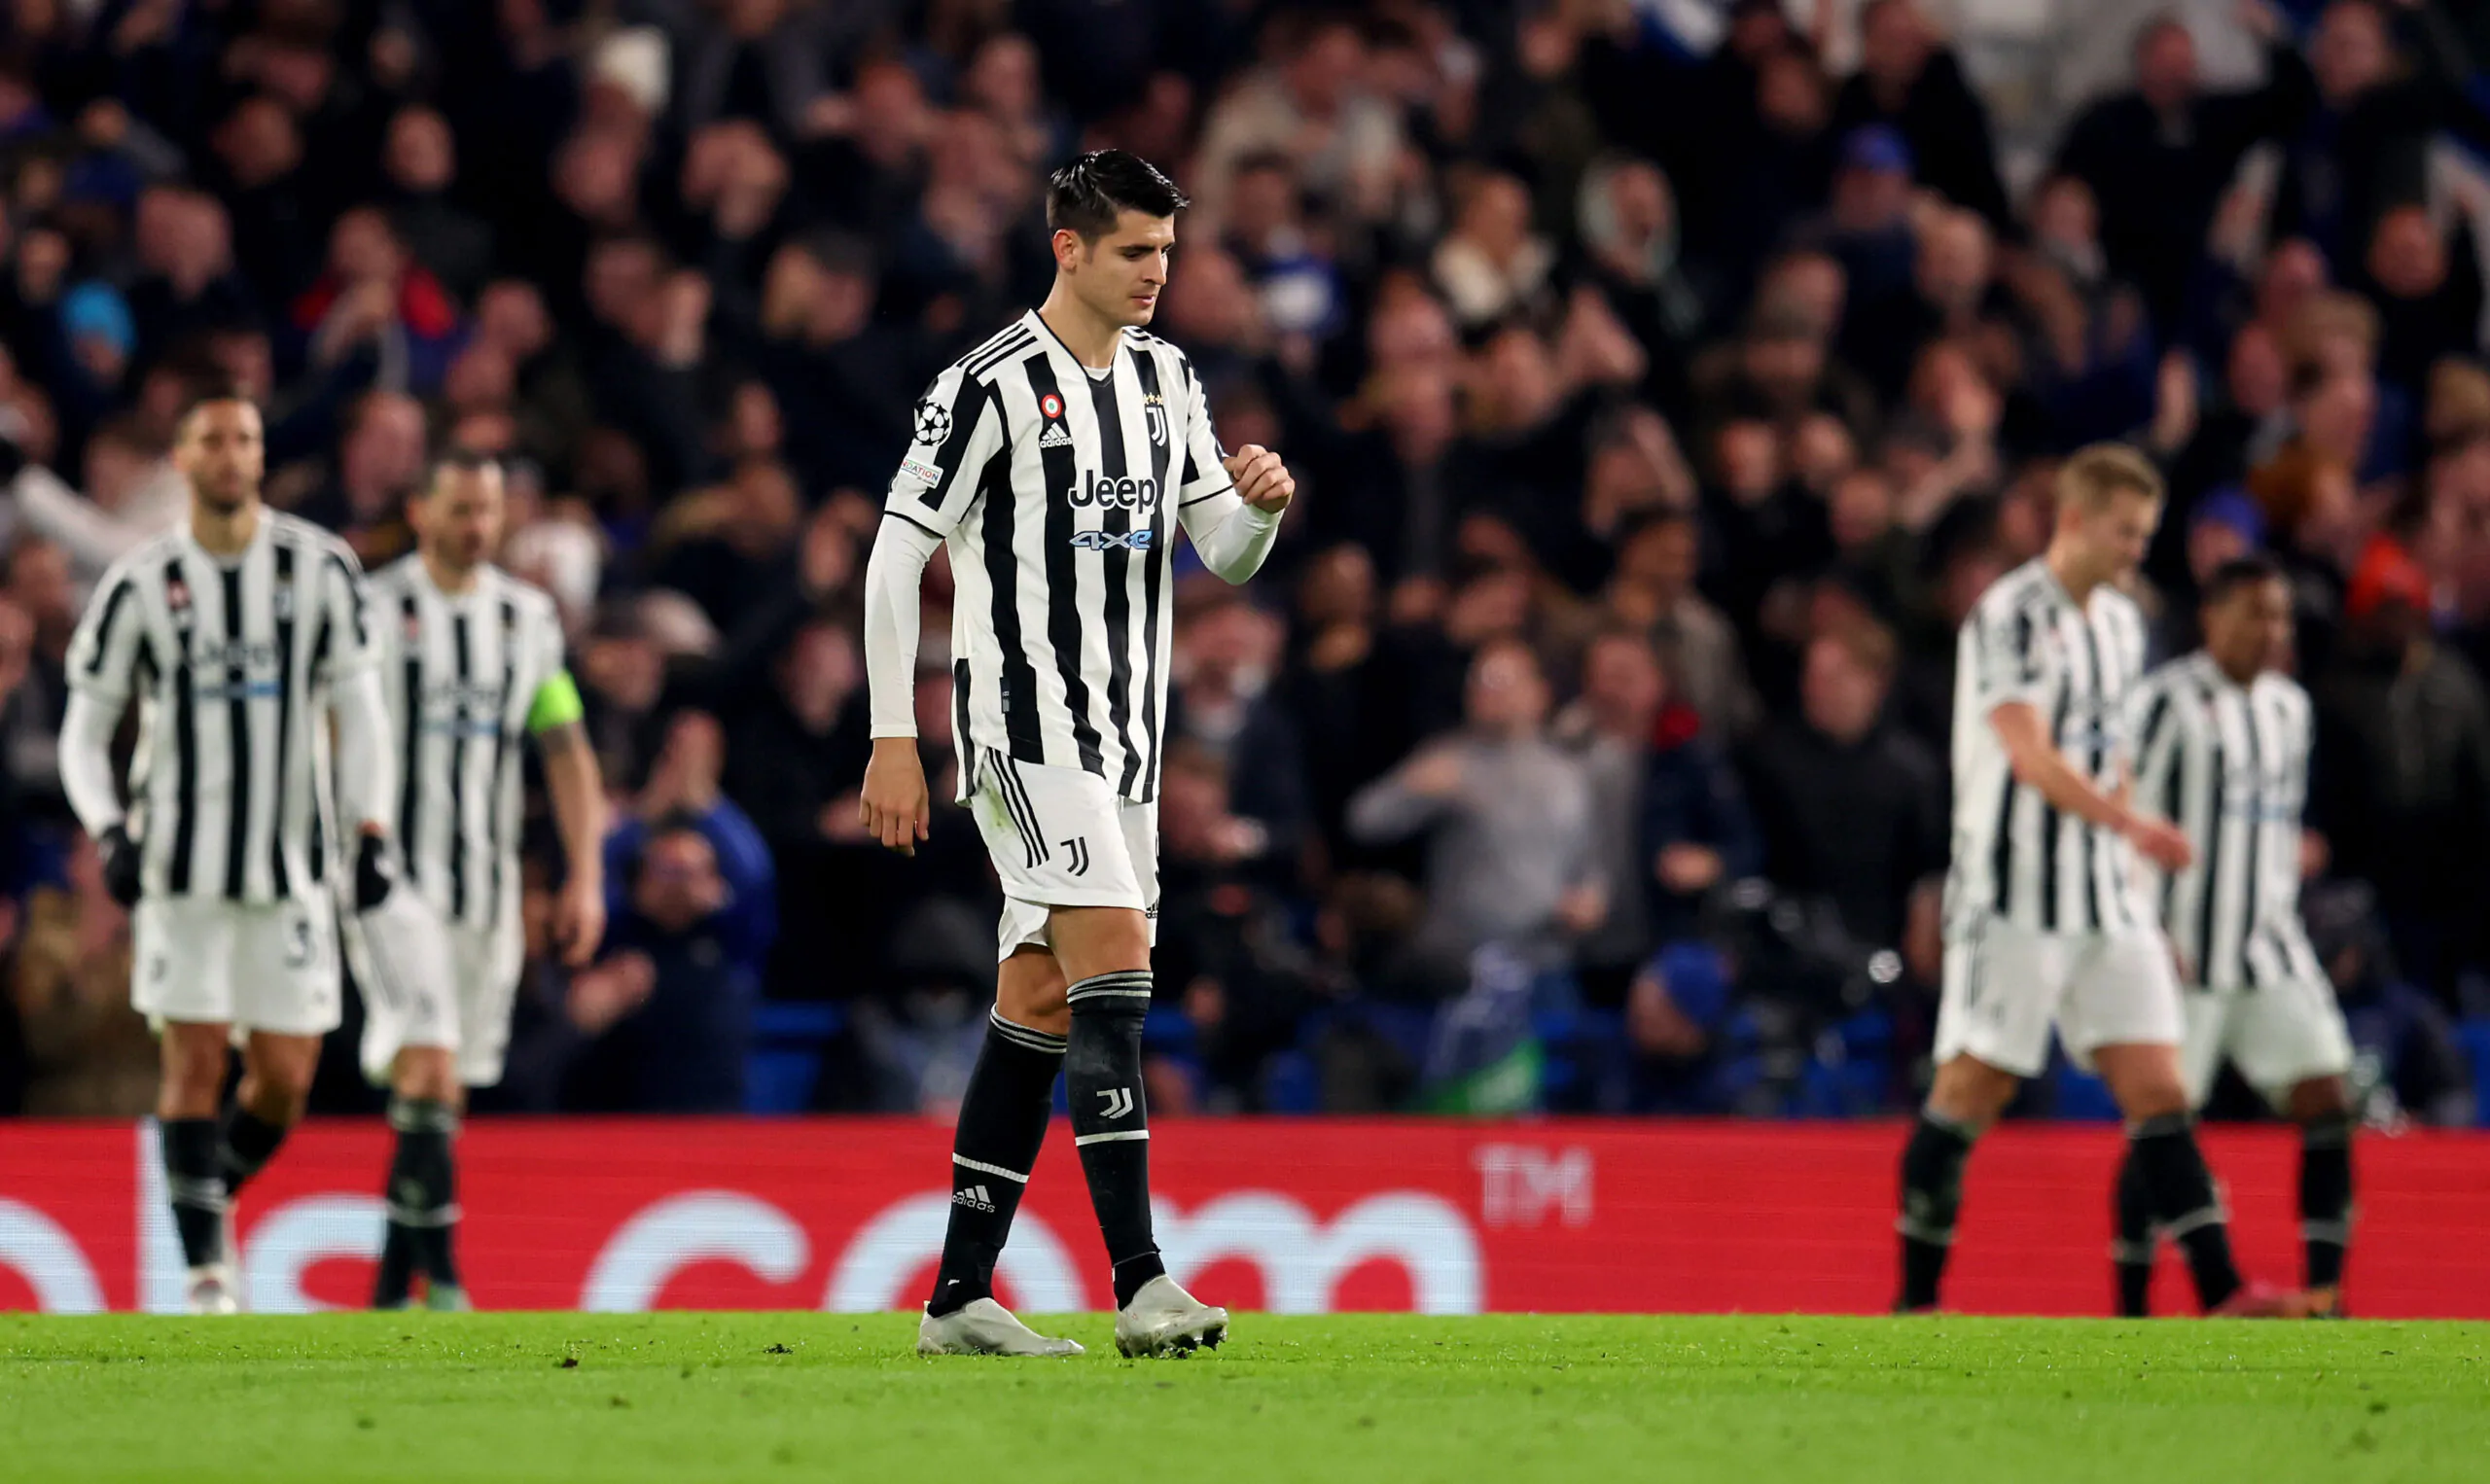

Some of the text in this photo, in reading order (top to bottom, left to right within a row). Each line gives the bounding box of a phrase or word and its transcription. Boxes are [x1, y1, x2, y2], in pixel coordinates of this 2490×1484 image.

[1039, 437, 1073, 448] adidas
[1069, 469, 1156, 514] Jeep
[952, 1191, 996, 1213] adidas
